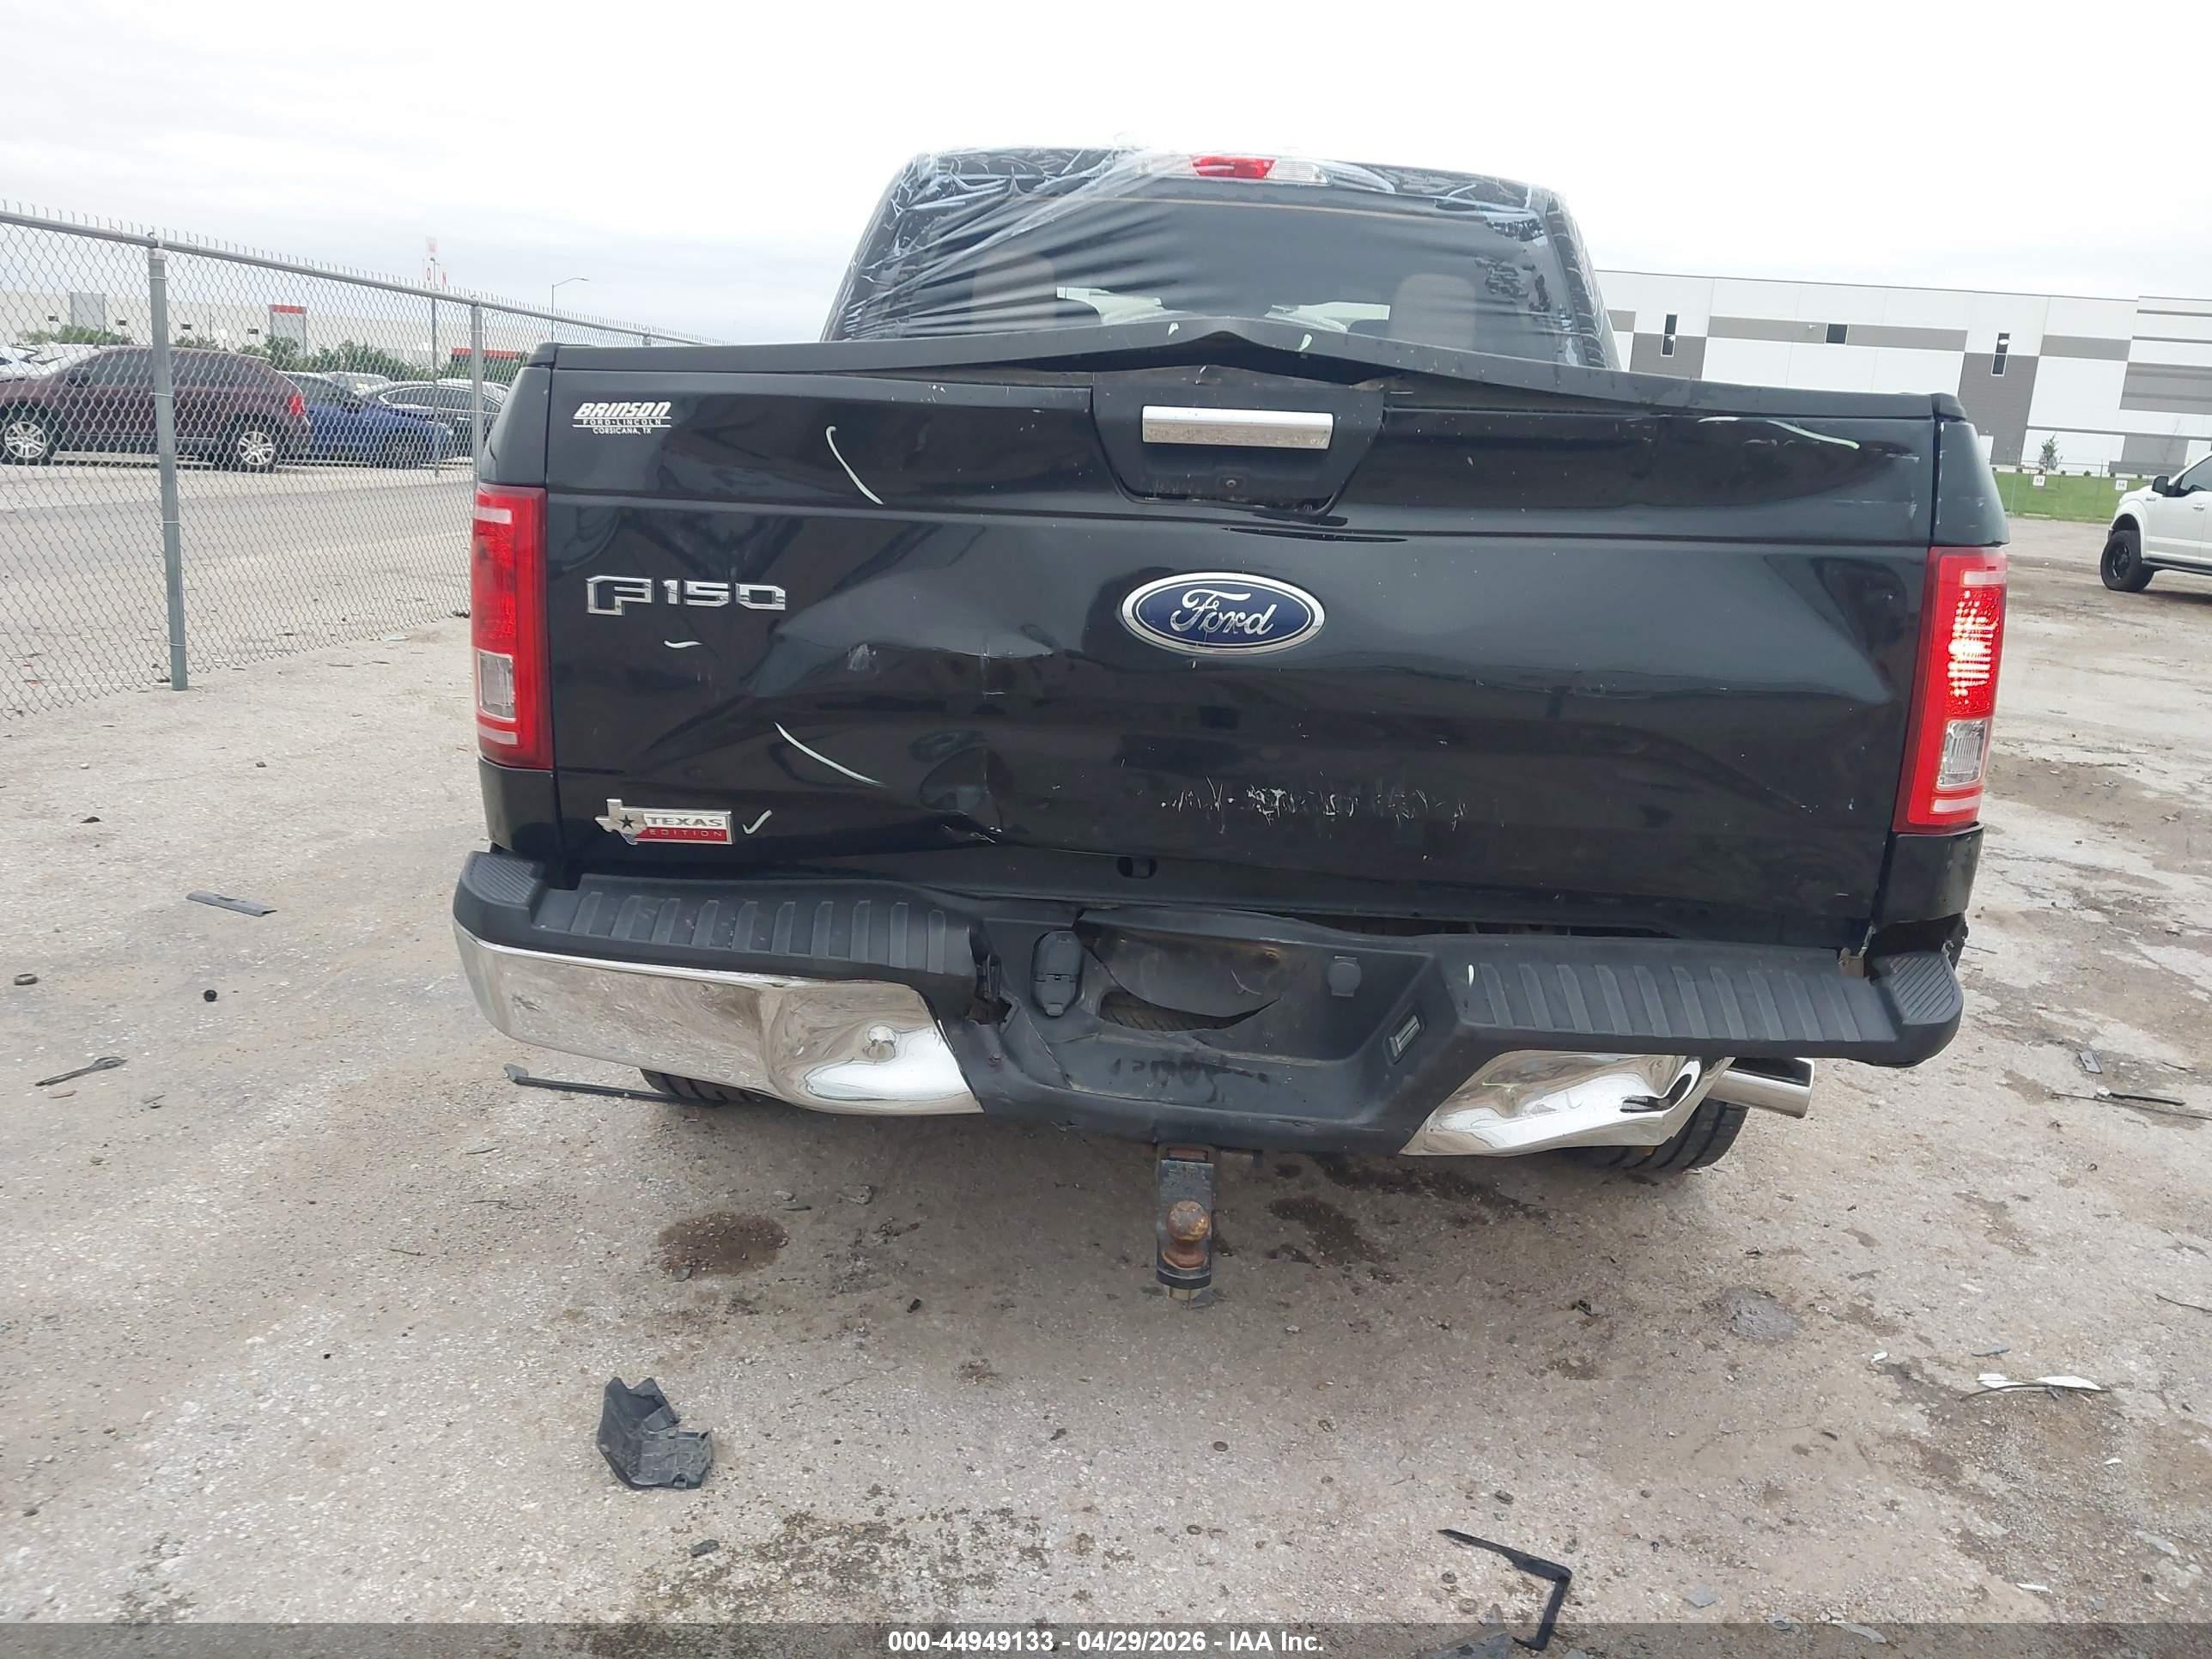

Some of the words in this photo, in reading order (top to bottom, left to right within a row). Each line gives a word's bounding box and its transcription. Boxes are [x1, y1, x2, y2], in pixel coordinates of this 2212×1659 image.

[574, 401, 672, 417] BRINSON
[1170, 588, 1278, 635] Ford
[647, 817, 722, 827] TEXAS
[648, 829, 723, 837] EDITION
